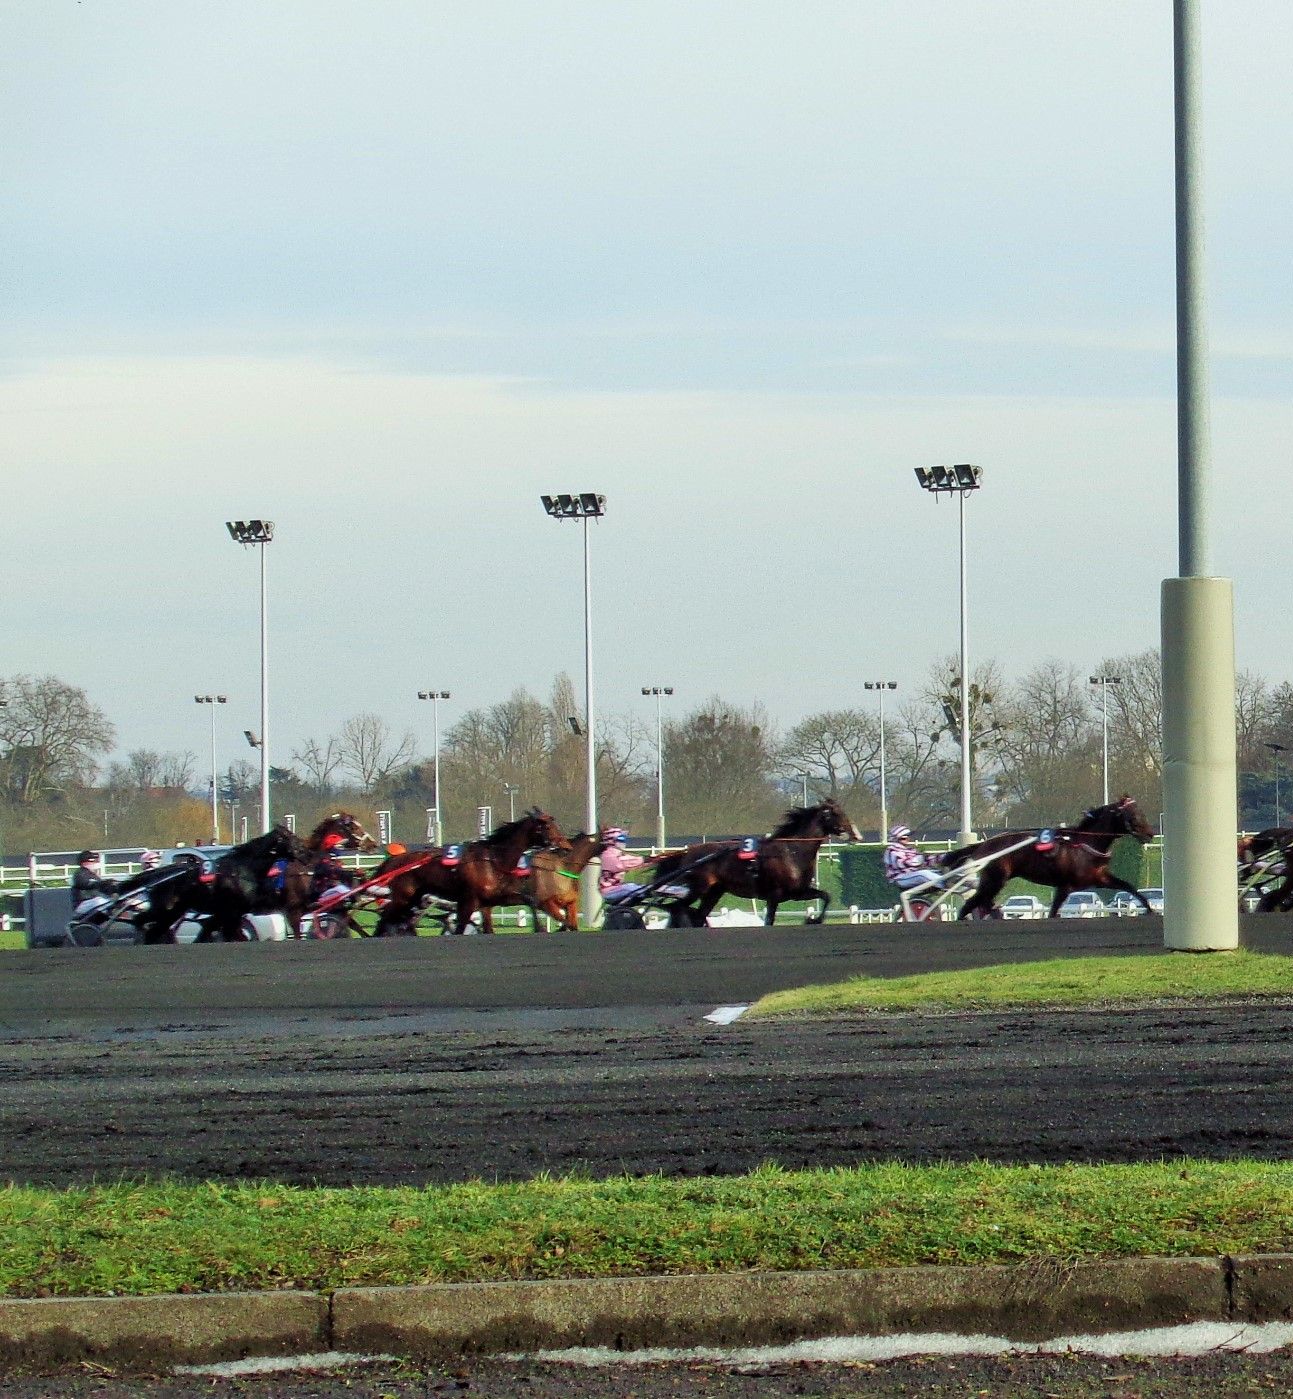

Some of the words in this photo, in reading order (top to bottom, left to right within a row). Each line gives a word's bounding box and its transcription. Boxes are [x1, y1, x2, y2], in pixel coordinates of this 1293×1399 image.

[1040, 830, 1050, 843] 6
[743, 838, 754, 851] 3
[446, 845, 458, 858] 5
